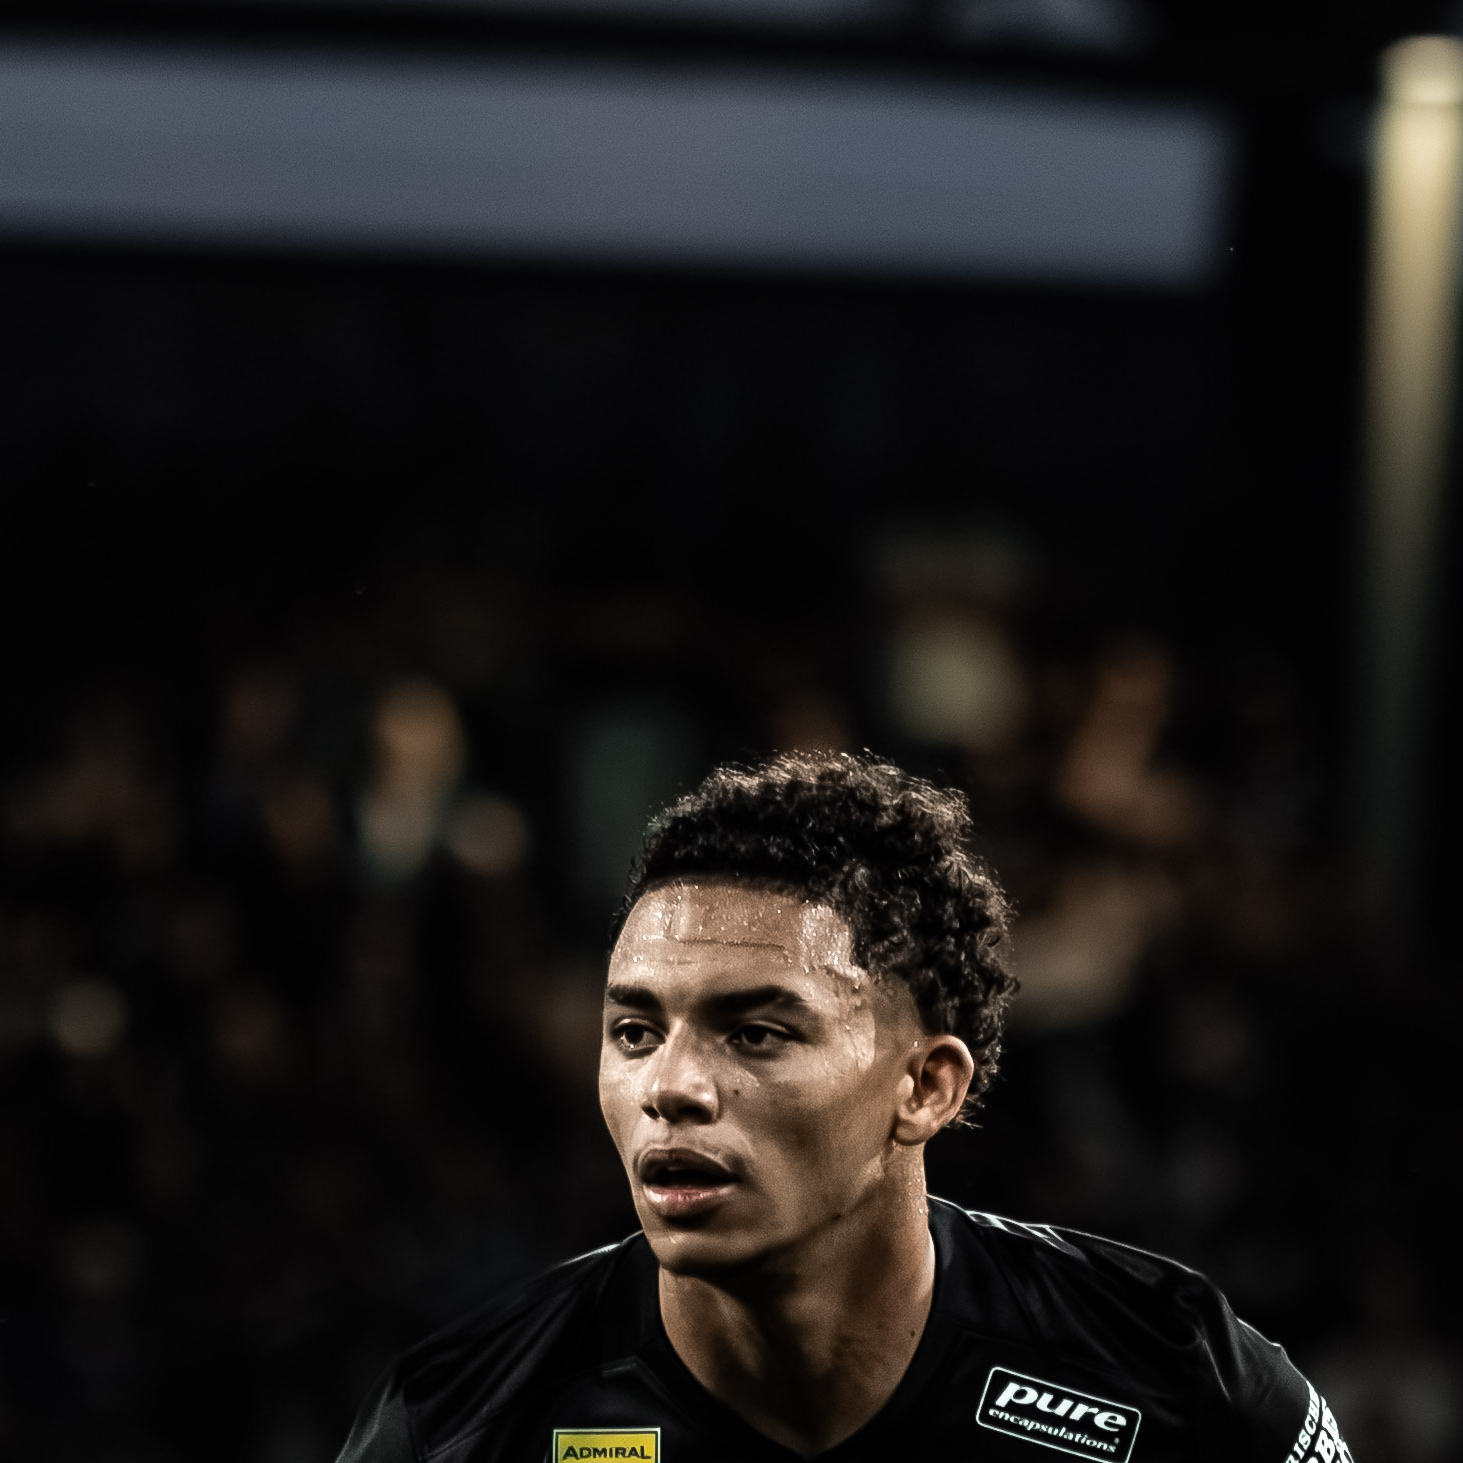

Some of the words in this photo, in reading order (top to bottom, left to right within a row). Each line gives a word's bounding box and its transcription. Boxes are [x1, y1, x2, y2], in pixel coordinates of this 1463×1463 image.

[995, 1382, 1127, 1432] pure
[562, 1445, 652, 1461] ADMIRAL
[989, 1408, 1117, 1453] encapsulations
